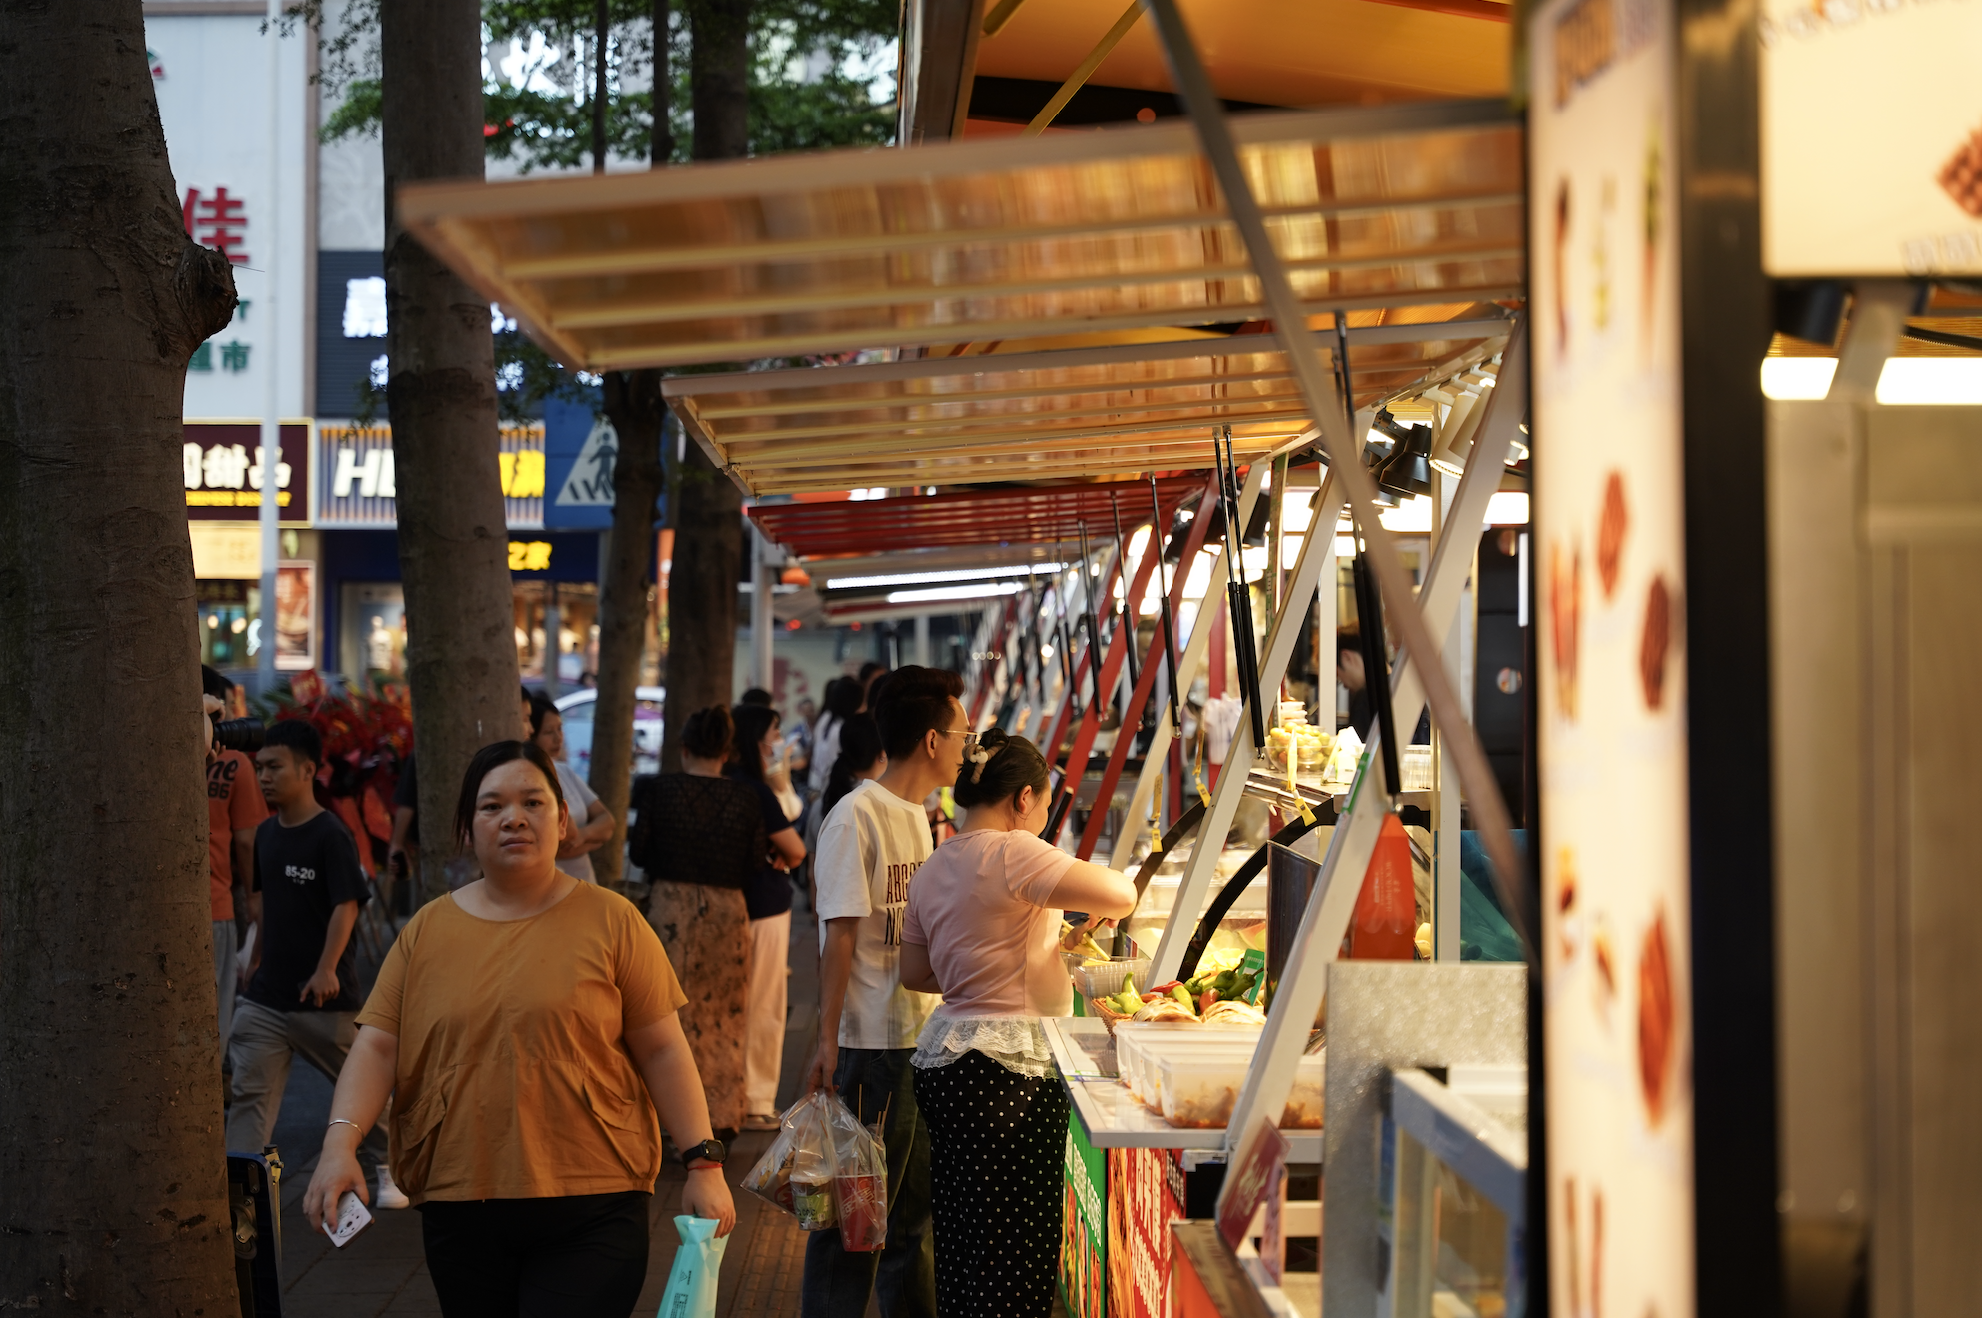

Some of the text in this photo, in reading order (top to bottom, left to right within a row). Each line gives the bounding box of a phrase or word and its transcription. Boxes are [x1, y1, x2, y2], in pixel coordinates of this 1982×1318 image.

[285, 864, 316, 881] 85-20
[886, 861, 926, 904] ABC
[884, 906, 905, 946] NO
